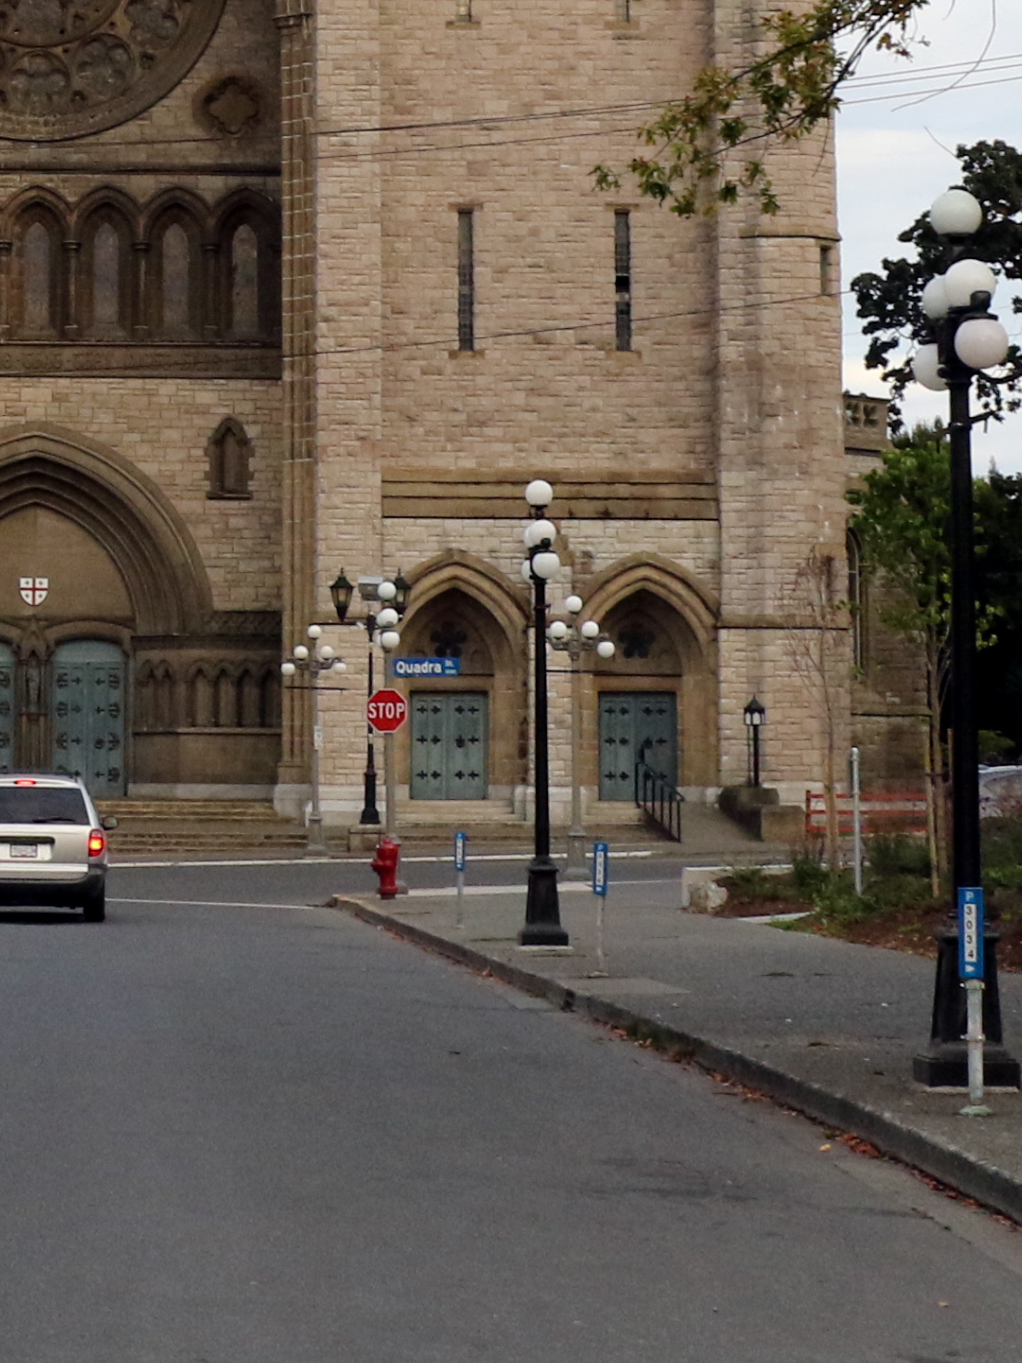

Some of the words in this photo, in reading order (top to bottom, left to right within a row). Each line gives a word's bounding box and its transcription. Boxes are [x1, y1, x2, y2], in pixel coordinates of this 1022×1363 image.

[396, 661, 442, 674] Quadra
[368, 702, 405, 719] STOP
[965, 891, 974, 901] P
